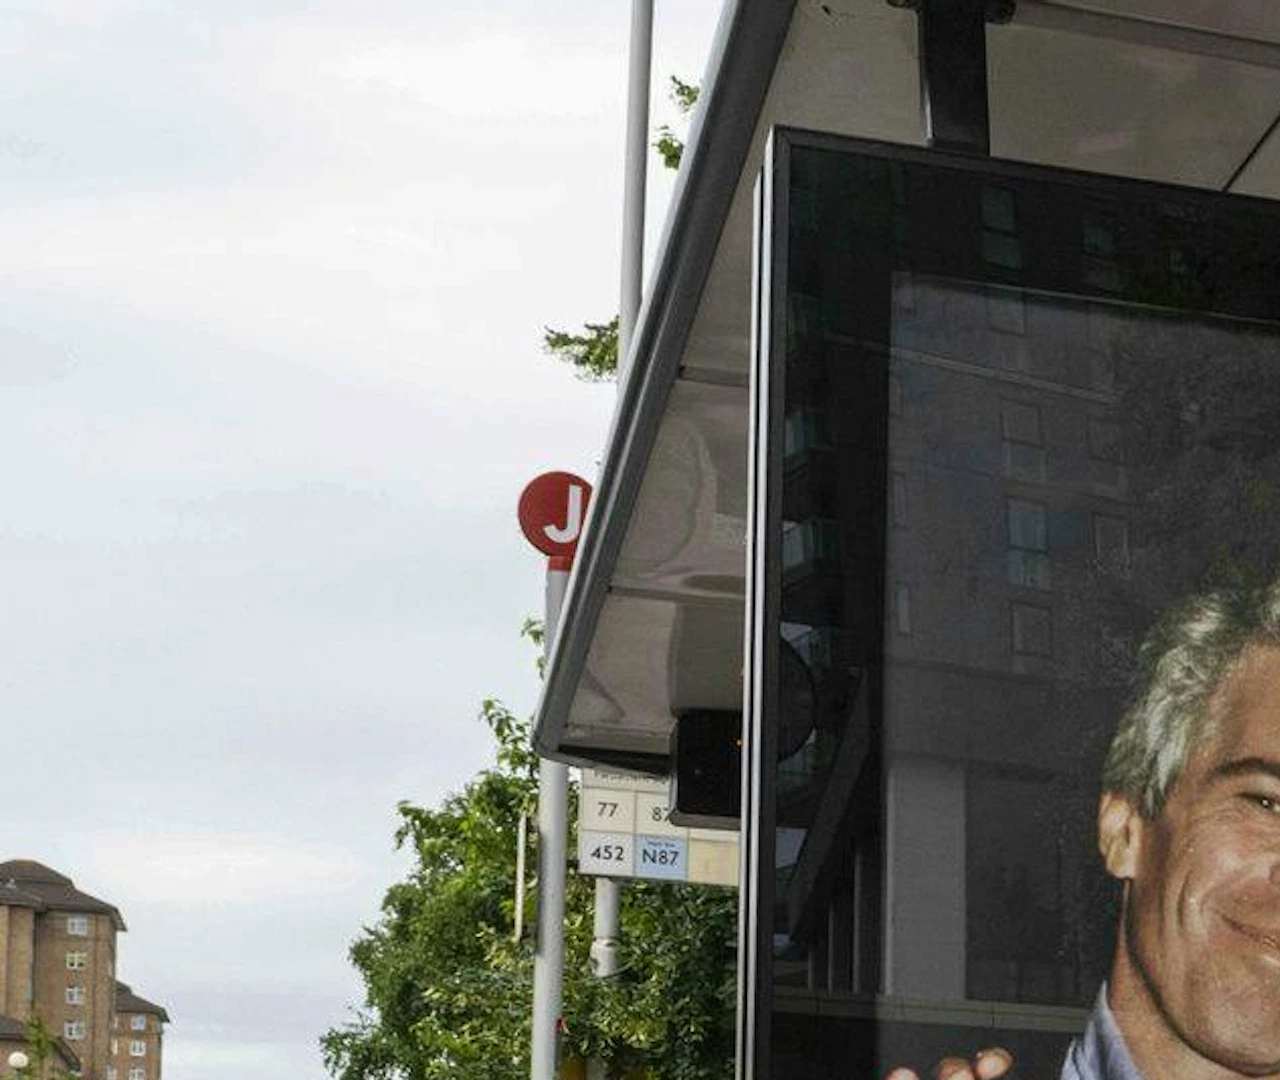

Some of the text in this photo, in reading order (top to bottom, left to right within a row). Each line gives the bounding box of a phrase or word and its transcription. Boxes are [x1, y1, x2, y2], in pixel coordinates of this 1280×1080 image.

[542, 484, 582, 544] J
[598, 802, 618, 818] 77
[590, 844, 625, 862] 452
[642, 848, 680, 866] N87
